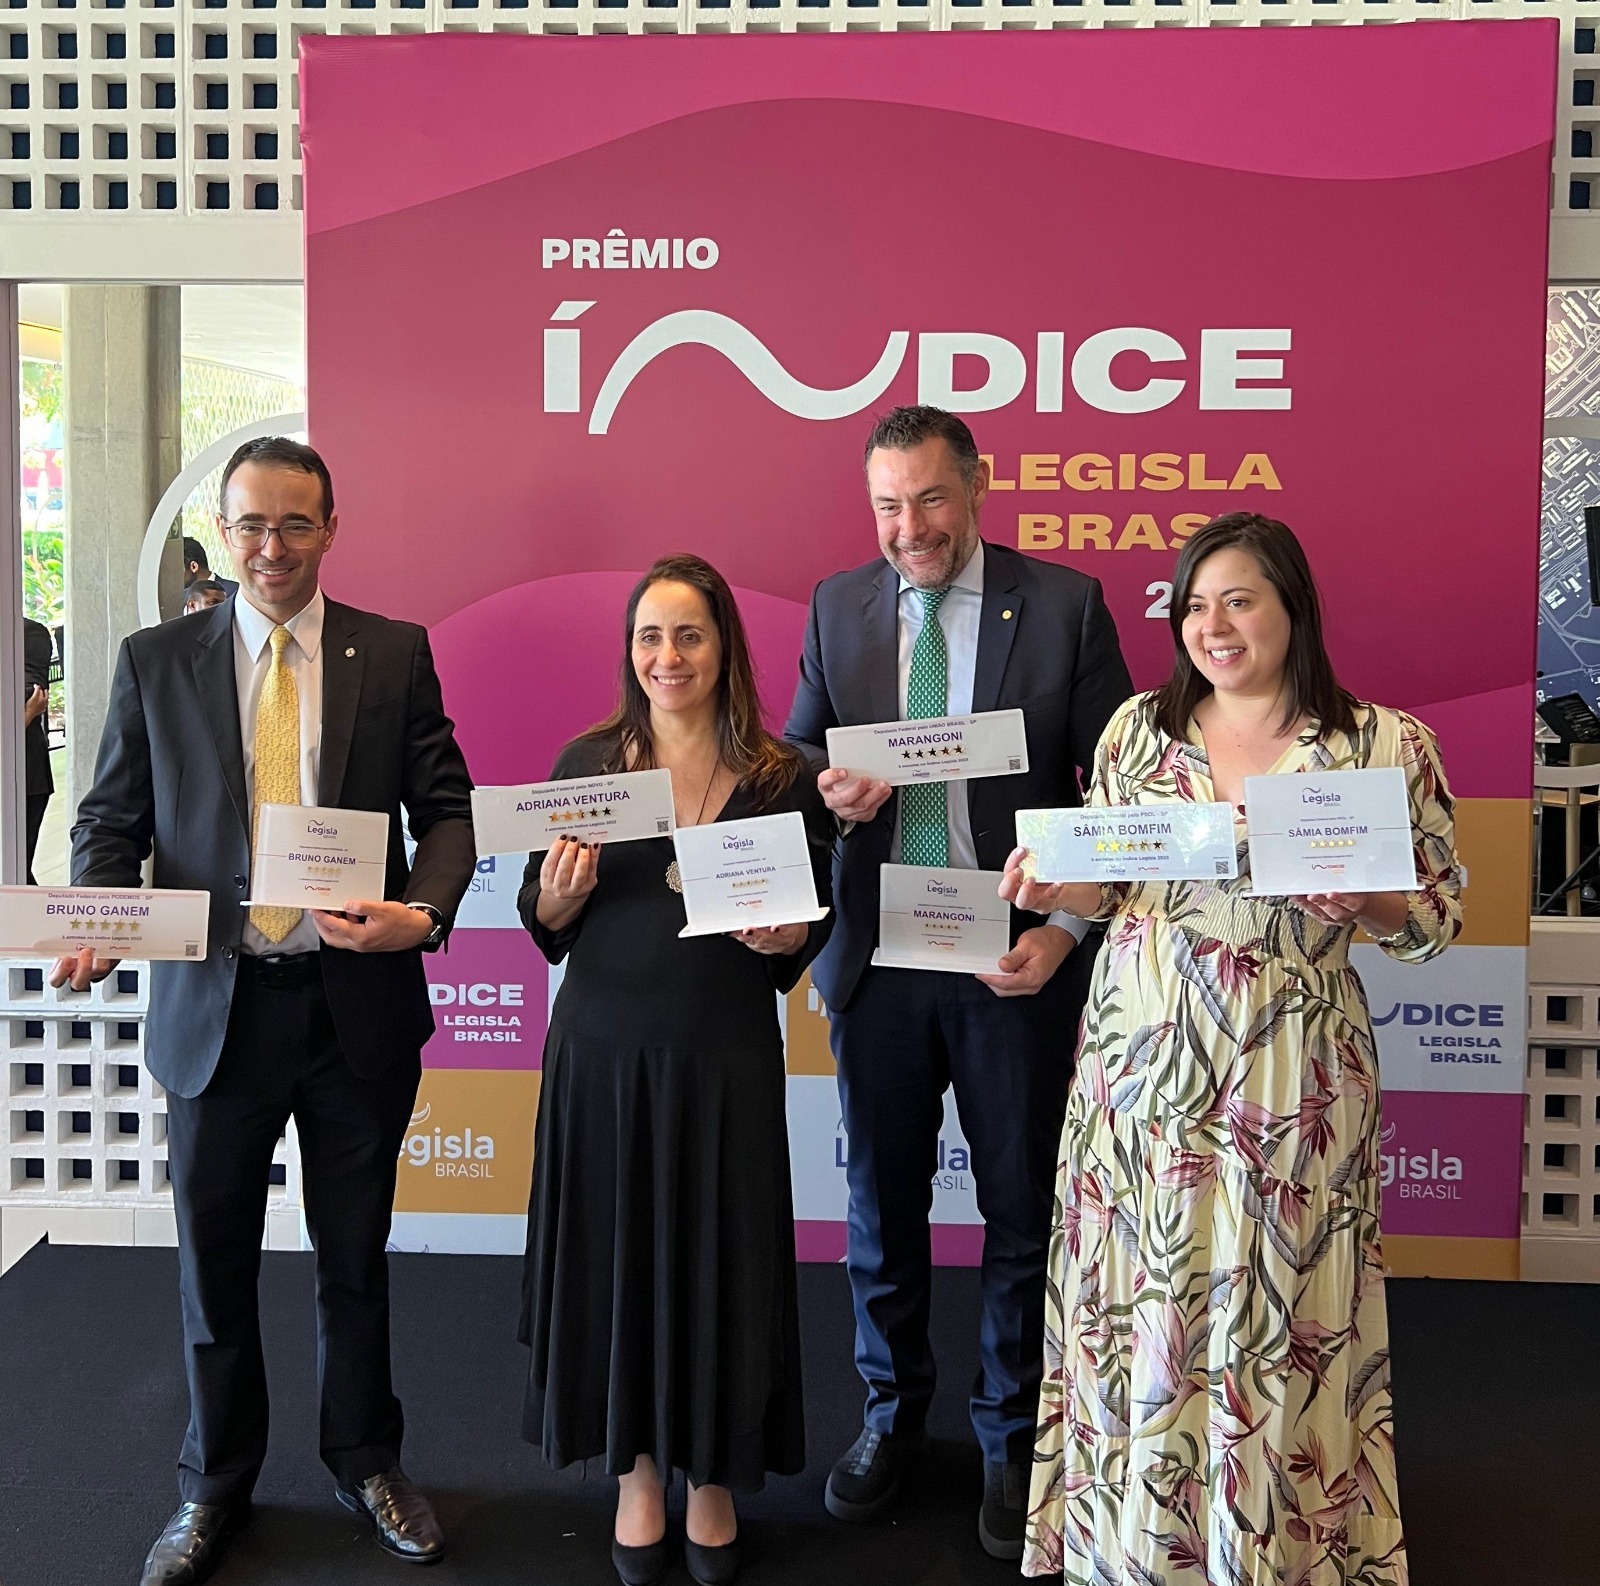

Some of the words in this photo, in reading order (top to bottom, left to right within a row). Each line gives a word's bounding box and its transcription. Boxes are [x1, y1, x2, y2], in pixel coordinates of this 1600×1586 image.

[542, 229, 720, 270] PRÊMIO
[977, 453, 1283, 491] LEGISLA
[1018, 513, 1211, 551] BRAS
[888, 731, 963, 748] MARANGONI
[516, 798, 570, 812] ADRIANA
[573, 790, 630, 805] VENTURA
[1302, 793, 1341, 804] Legisla
[308, 826, 338, 836] Legisla
[1074, 824, 1114, 837] SÂMIA
[1119, 823, 1172, 836] BOMFIM
[1288, 827, 1322, 838] SÂMIA
[1325, 826, 1368, 836] BOMFIM
[722, 838, 754, 851] Legisla
[288, 853, 321, 863] BRUNO
[324, 855, 356, 865] GANEM
[715, 870, 744, 880] ADRIANA
[746, 866, 776, 875] VENTURA
[468, 878, 496, 893] SIL
[927, 885, 958, 894] Legisla
[46, 904, 96, 916] BRUNO
[100, 906, 149, 916] GANEM
[913, 910, 975, 922] MARANGONI
[428, 983, 524, 1006] DICE
[443, 1015, 522, 1027] LEGISLA
[1370, 1003, 1504, 1027] DICE
[454, 1030, 522, 1042] BRASIL
[1419, 1036, 1502, 1048] LEGISLA
[1430, 1052, 1502, 1064] BRASIL
[399, 1126, 494, 1166] gisla
[435, 1162, 494, 1178] BRASIL
[1379, 1147, 1462, 1187] gisla
[931, 1175, 969, 1190] ASIL
[1400, 1183, 1462, 1200] BRASIL
